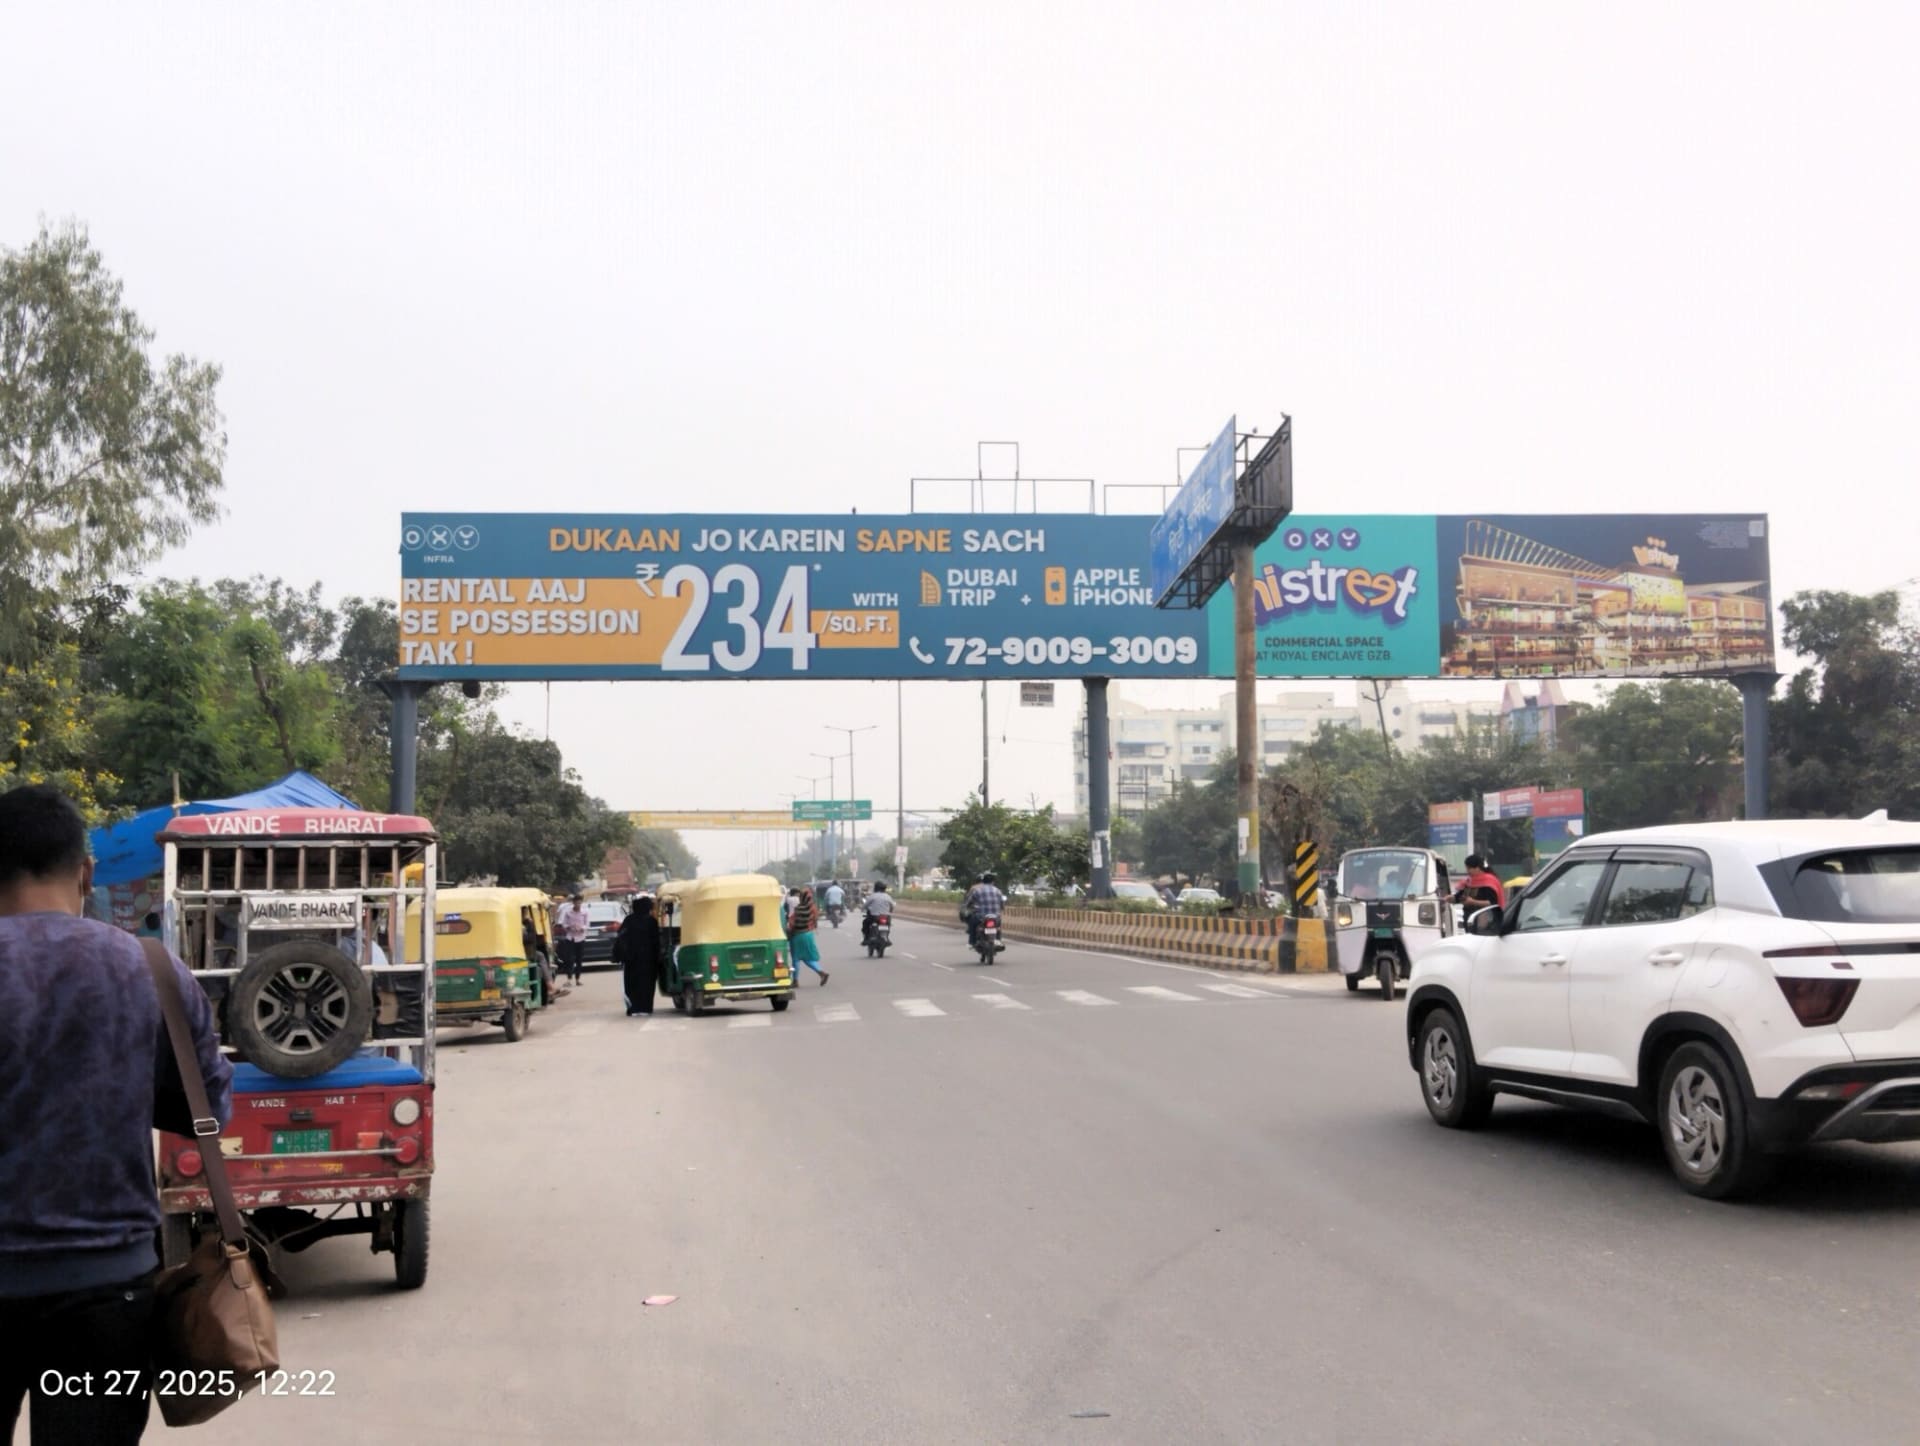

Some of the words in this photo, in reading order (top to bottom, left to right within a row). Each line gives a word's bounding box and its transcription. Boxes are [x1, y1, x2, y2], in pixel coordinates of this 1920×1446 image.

[549, 528, 681, 552] DUKAAN
[692, 528, 733, 552] JO
[738, 528, 845, 552] KAREIN
[856, 528, 952, 553] SAPNE
[963, 529, 1046, 553] SACH
[423, 555, 455, 564] INFRA
[946, 568, 1018, 587] DUBAI
[1073, 568, 1141, 587] APPLE
[402, 579, 516, 603] RENTAL
[526, 579, 587, 603] AAJ
[852, 592, 899, 607] WITH
[946, 588, 997, 606] TRIP
[402, 609, 440, 634] SE
[449, 609, 640, 634] POSSESSION
[944, 636, 1198, 666] 72-9009-3009
[1264, 636, 1343, 648] COMMERCIAL
[1345, 636, 1385, 648] SPACE
[1311, 650, 1364, 662] ENCLAVE
[205, 815, 281, 835] VANDE
[250, 902, 297, 918] VANDE
[300, 902, 355, 918] BHARAT
[251, 1098, 287, 1109] VANDE
